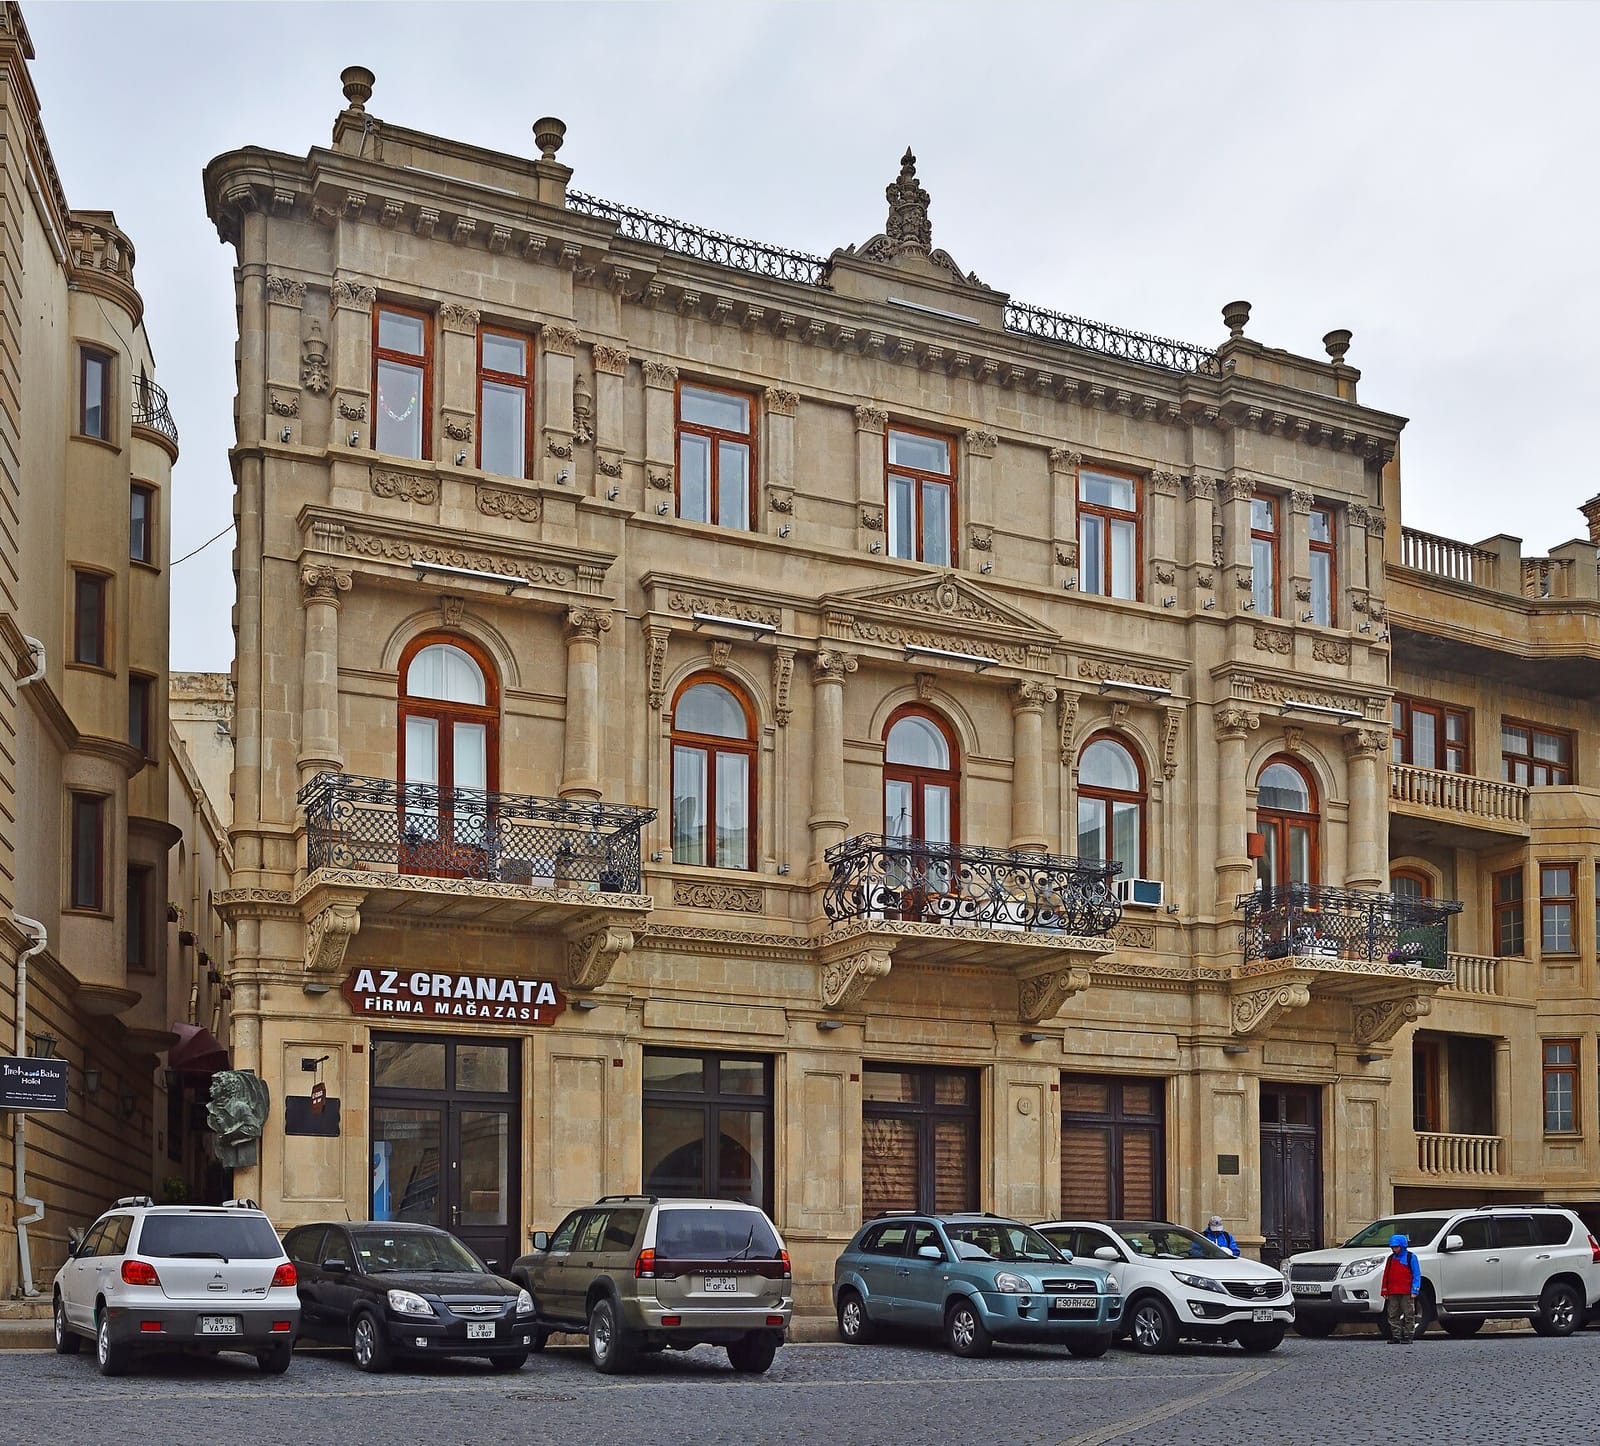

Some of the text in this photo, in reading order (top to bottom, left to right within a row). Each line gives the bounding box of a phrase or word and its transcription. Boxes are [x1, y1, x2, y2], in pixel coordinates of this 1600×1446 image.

[353, 969, 557, 1005] AZ-GRANATA
[364, 996, 539, 1020] FİRMA MAĞAZASI
[21, 1077, 41, 1085] Hotel
[40, 1069, 60, 1078] Baku
